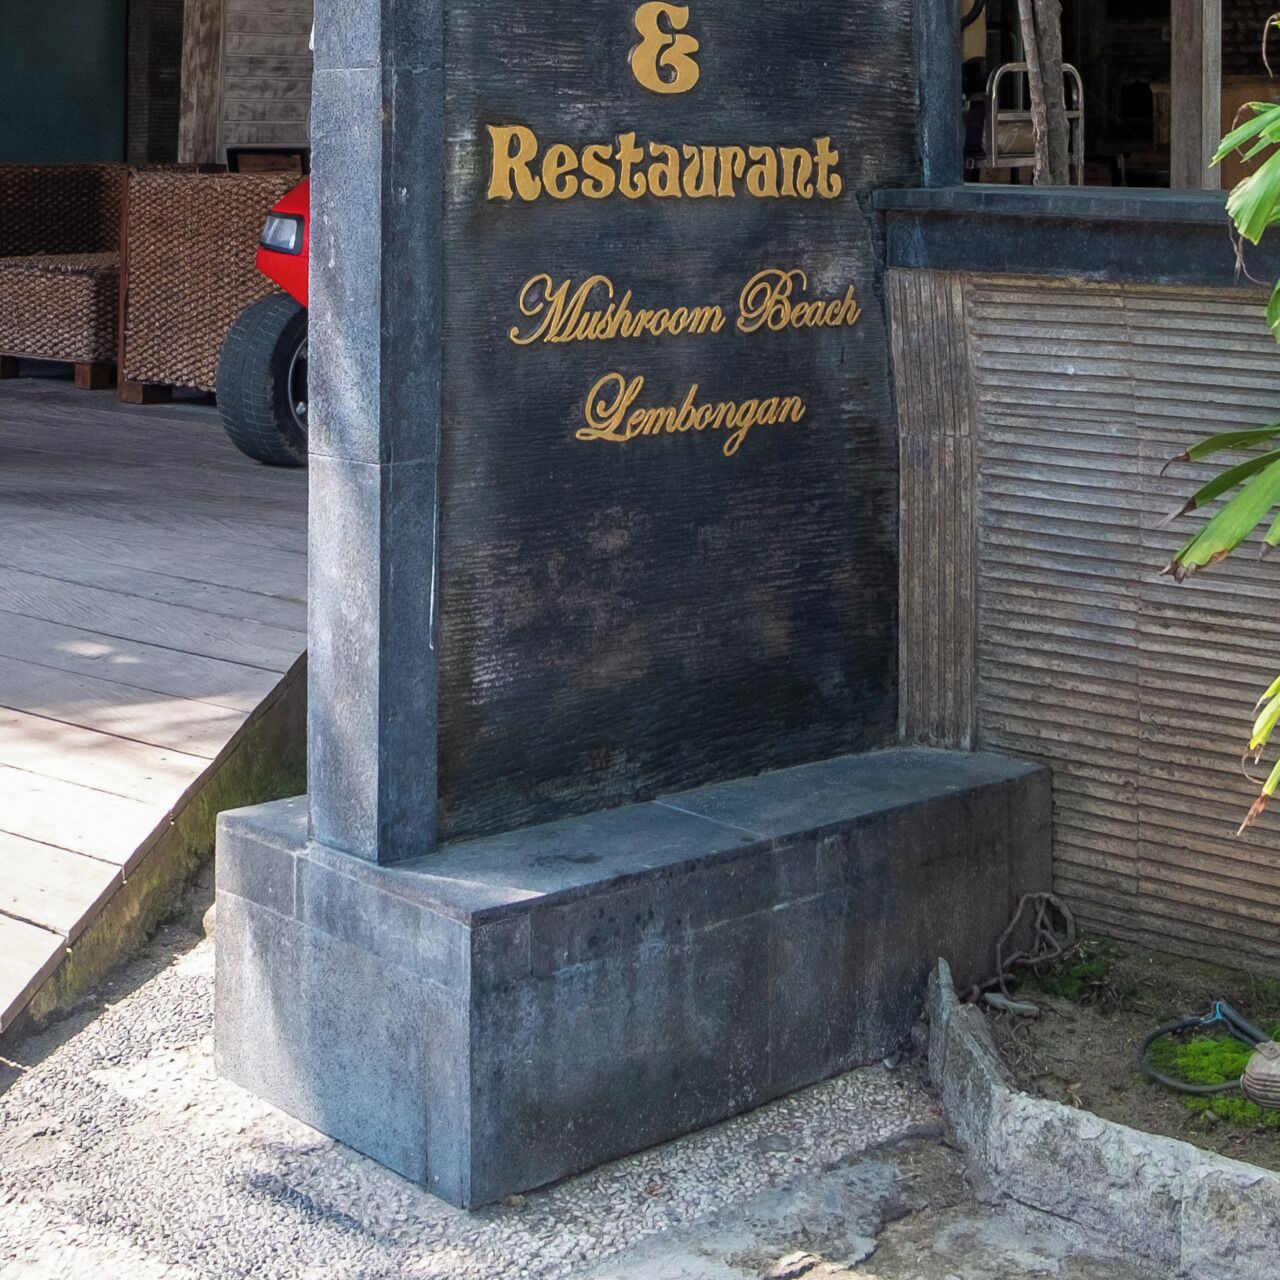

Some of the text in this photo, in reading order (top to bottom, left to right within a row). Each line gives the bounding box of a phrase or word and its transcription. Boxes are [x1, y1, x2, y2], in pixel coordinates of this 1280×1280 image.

[631, 1, 700, 94] &
[486, 125, 842, 201] Restaurant
[511, 269, 862, 345] Mushroom Beach
[576, 373, 806, 456] Lembongan
